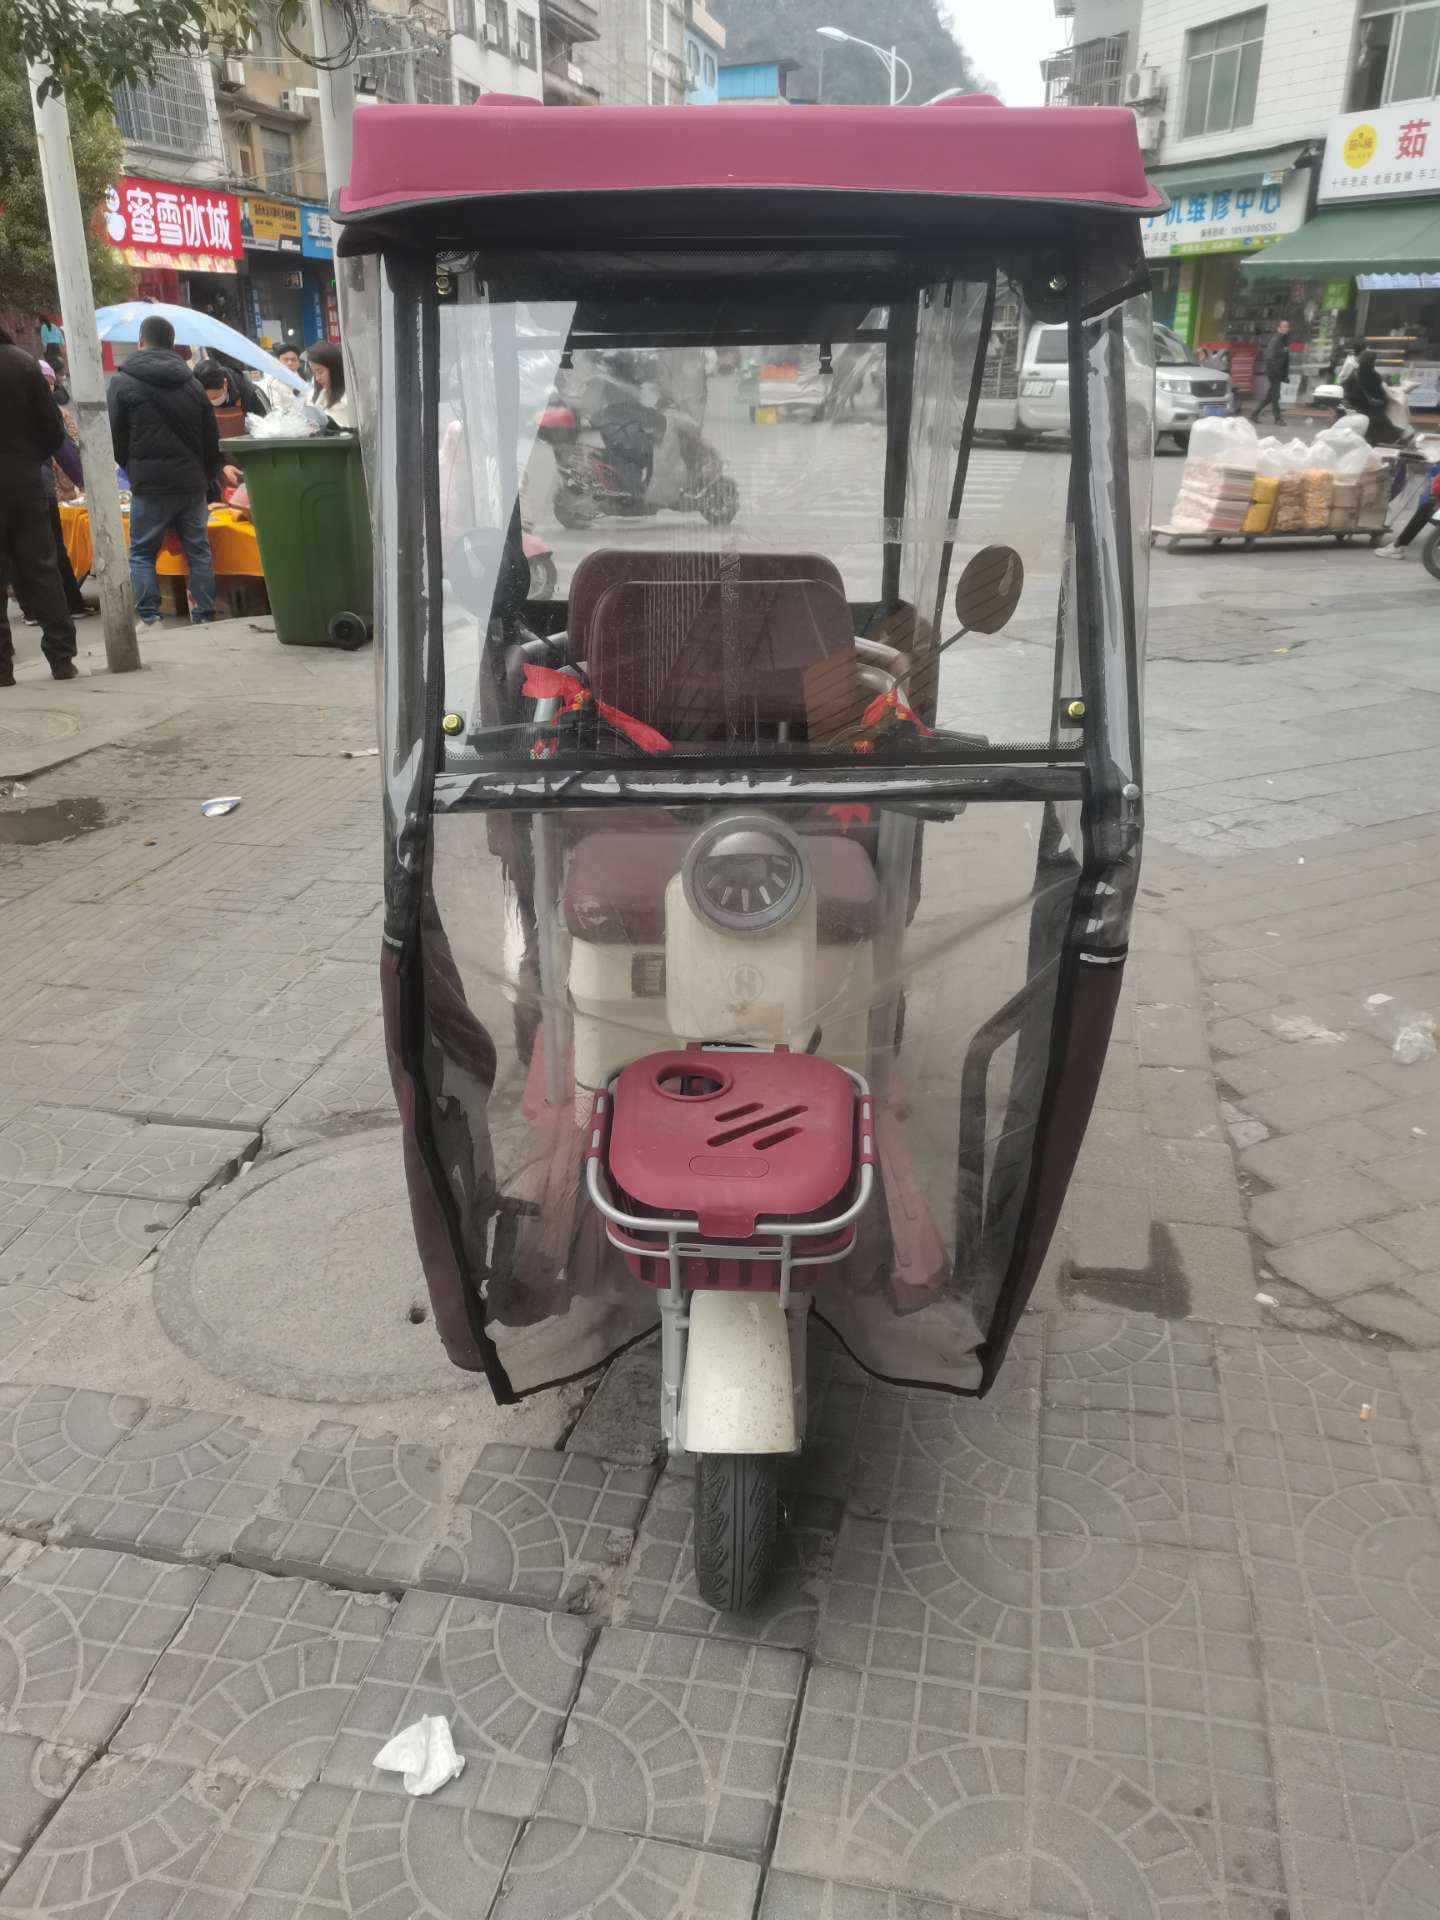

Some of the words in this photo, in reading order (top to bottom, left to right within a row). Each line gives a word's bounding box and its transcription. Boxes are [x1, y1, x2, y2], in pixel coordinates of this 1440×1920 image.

[1395, 118, 1431, 160] 茹
[126, 187, 233, 251] 蜜雪冰城
